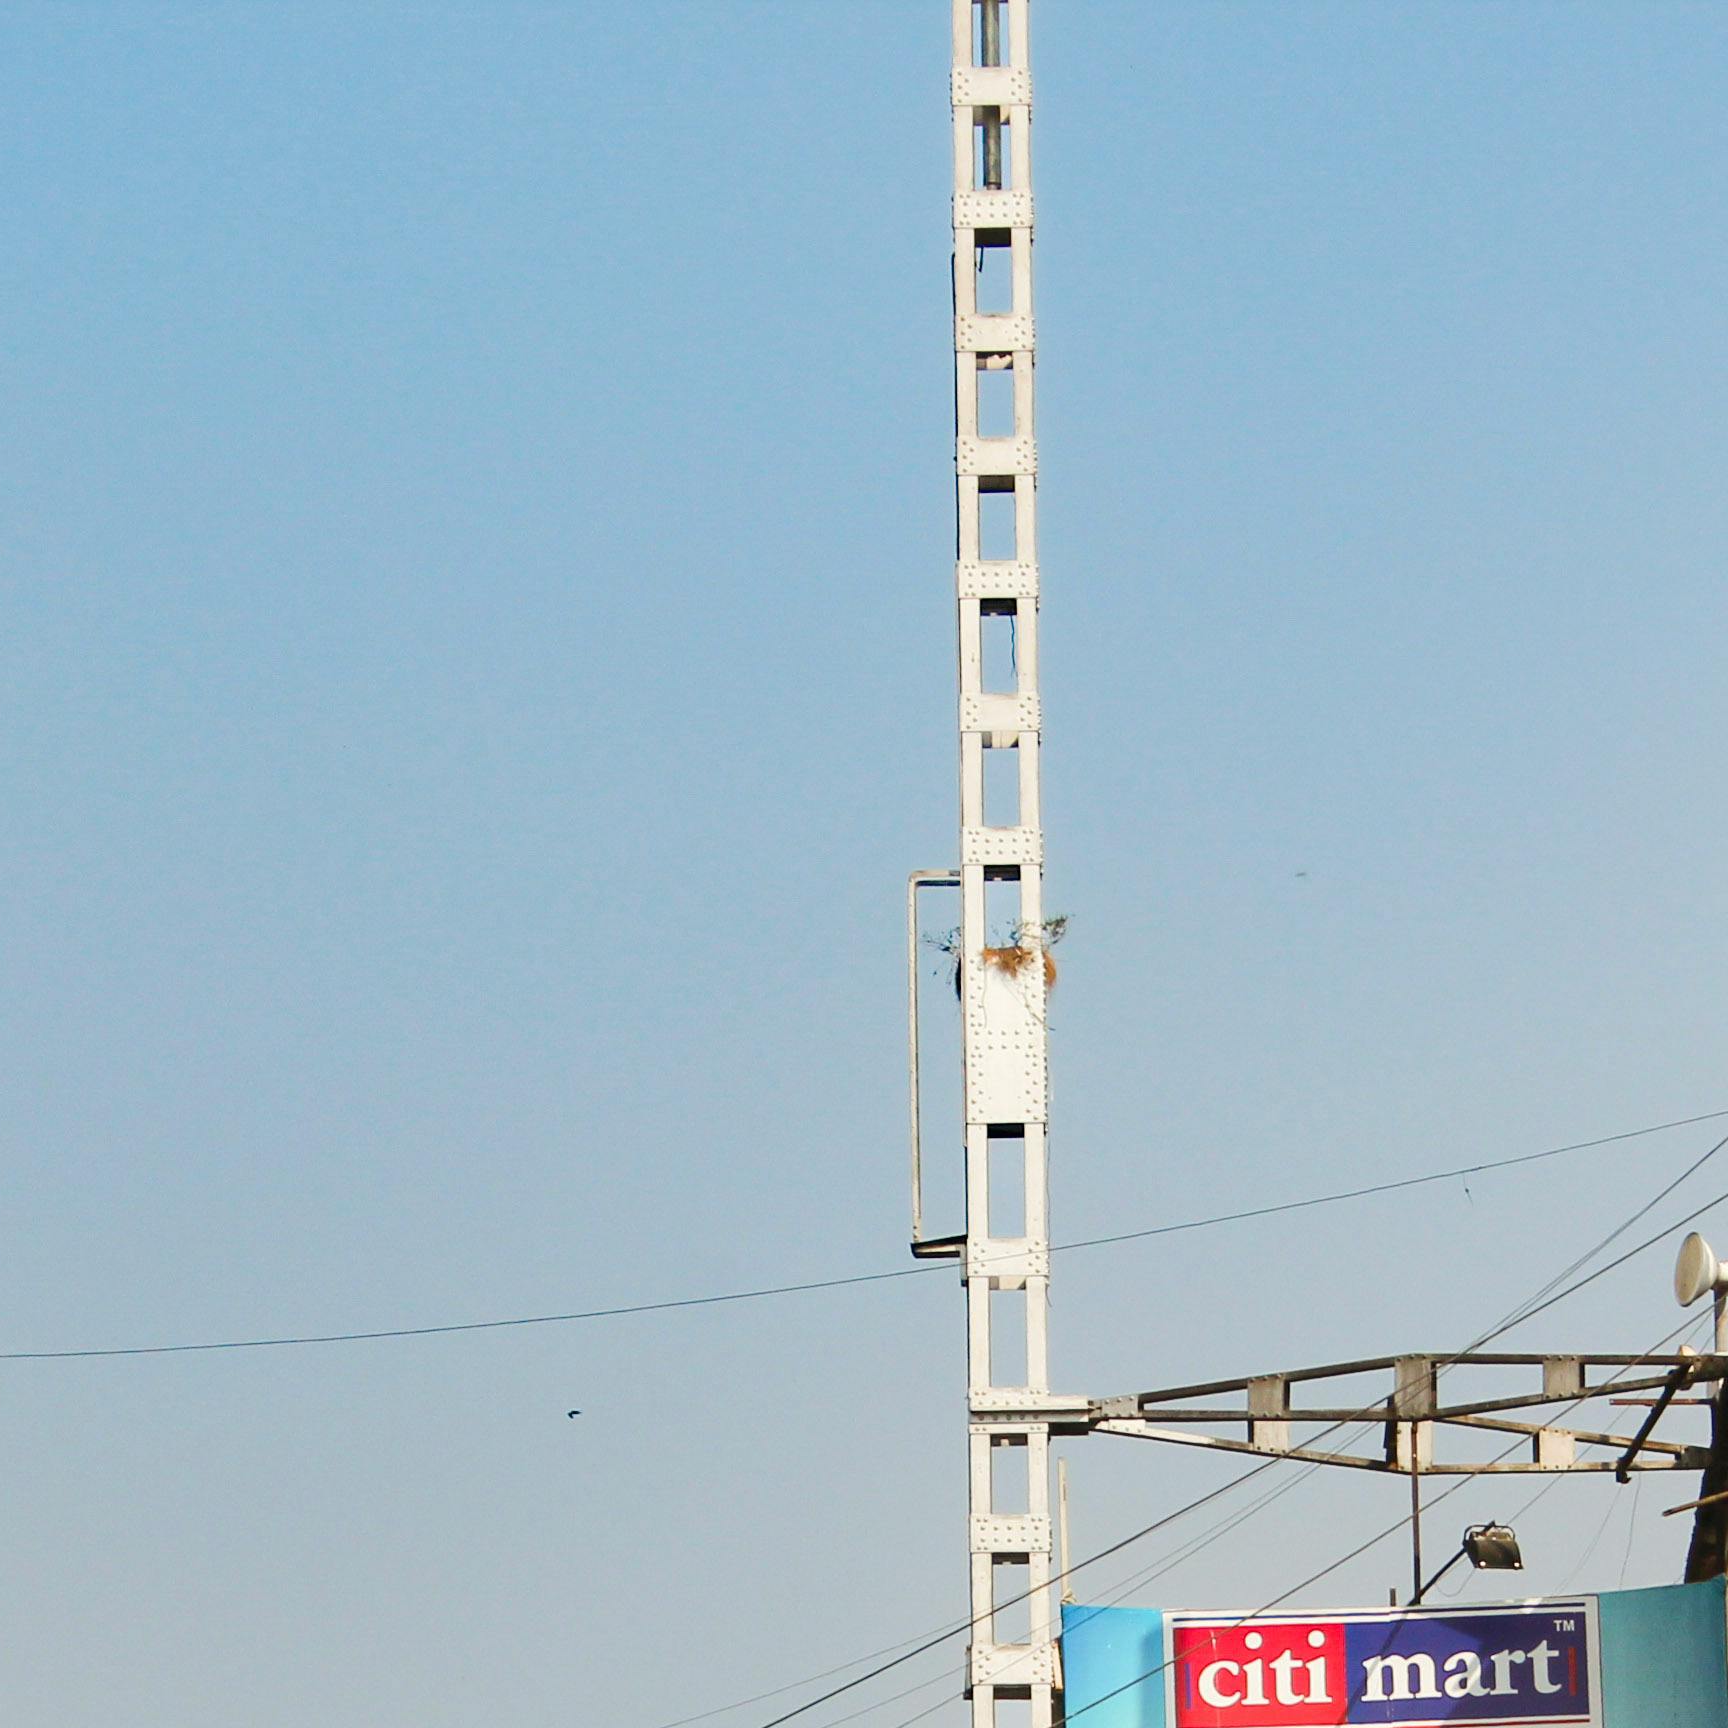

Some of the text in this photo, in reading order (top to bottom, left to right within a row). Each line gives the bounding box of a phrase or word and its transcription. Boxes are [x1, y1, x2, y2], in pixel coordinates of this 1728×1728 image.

[1197, 1618, 1576, 1709] citi mart TM
